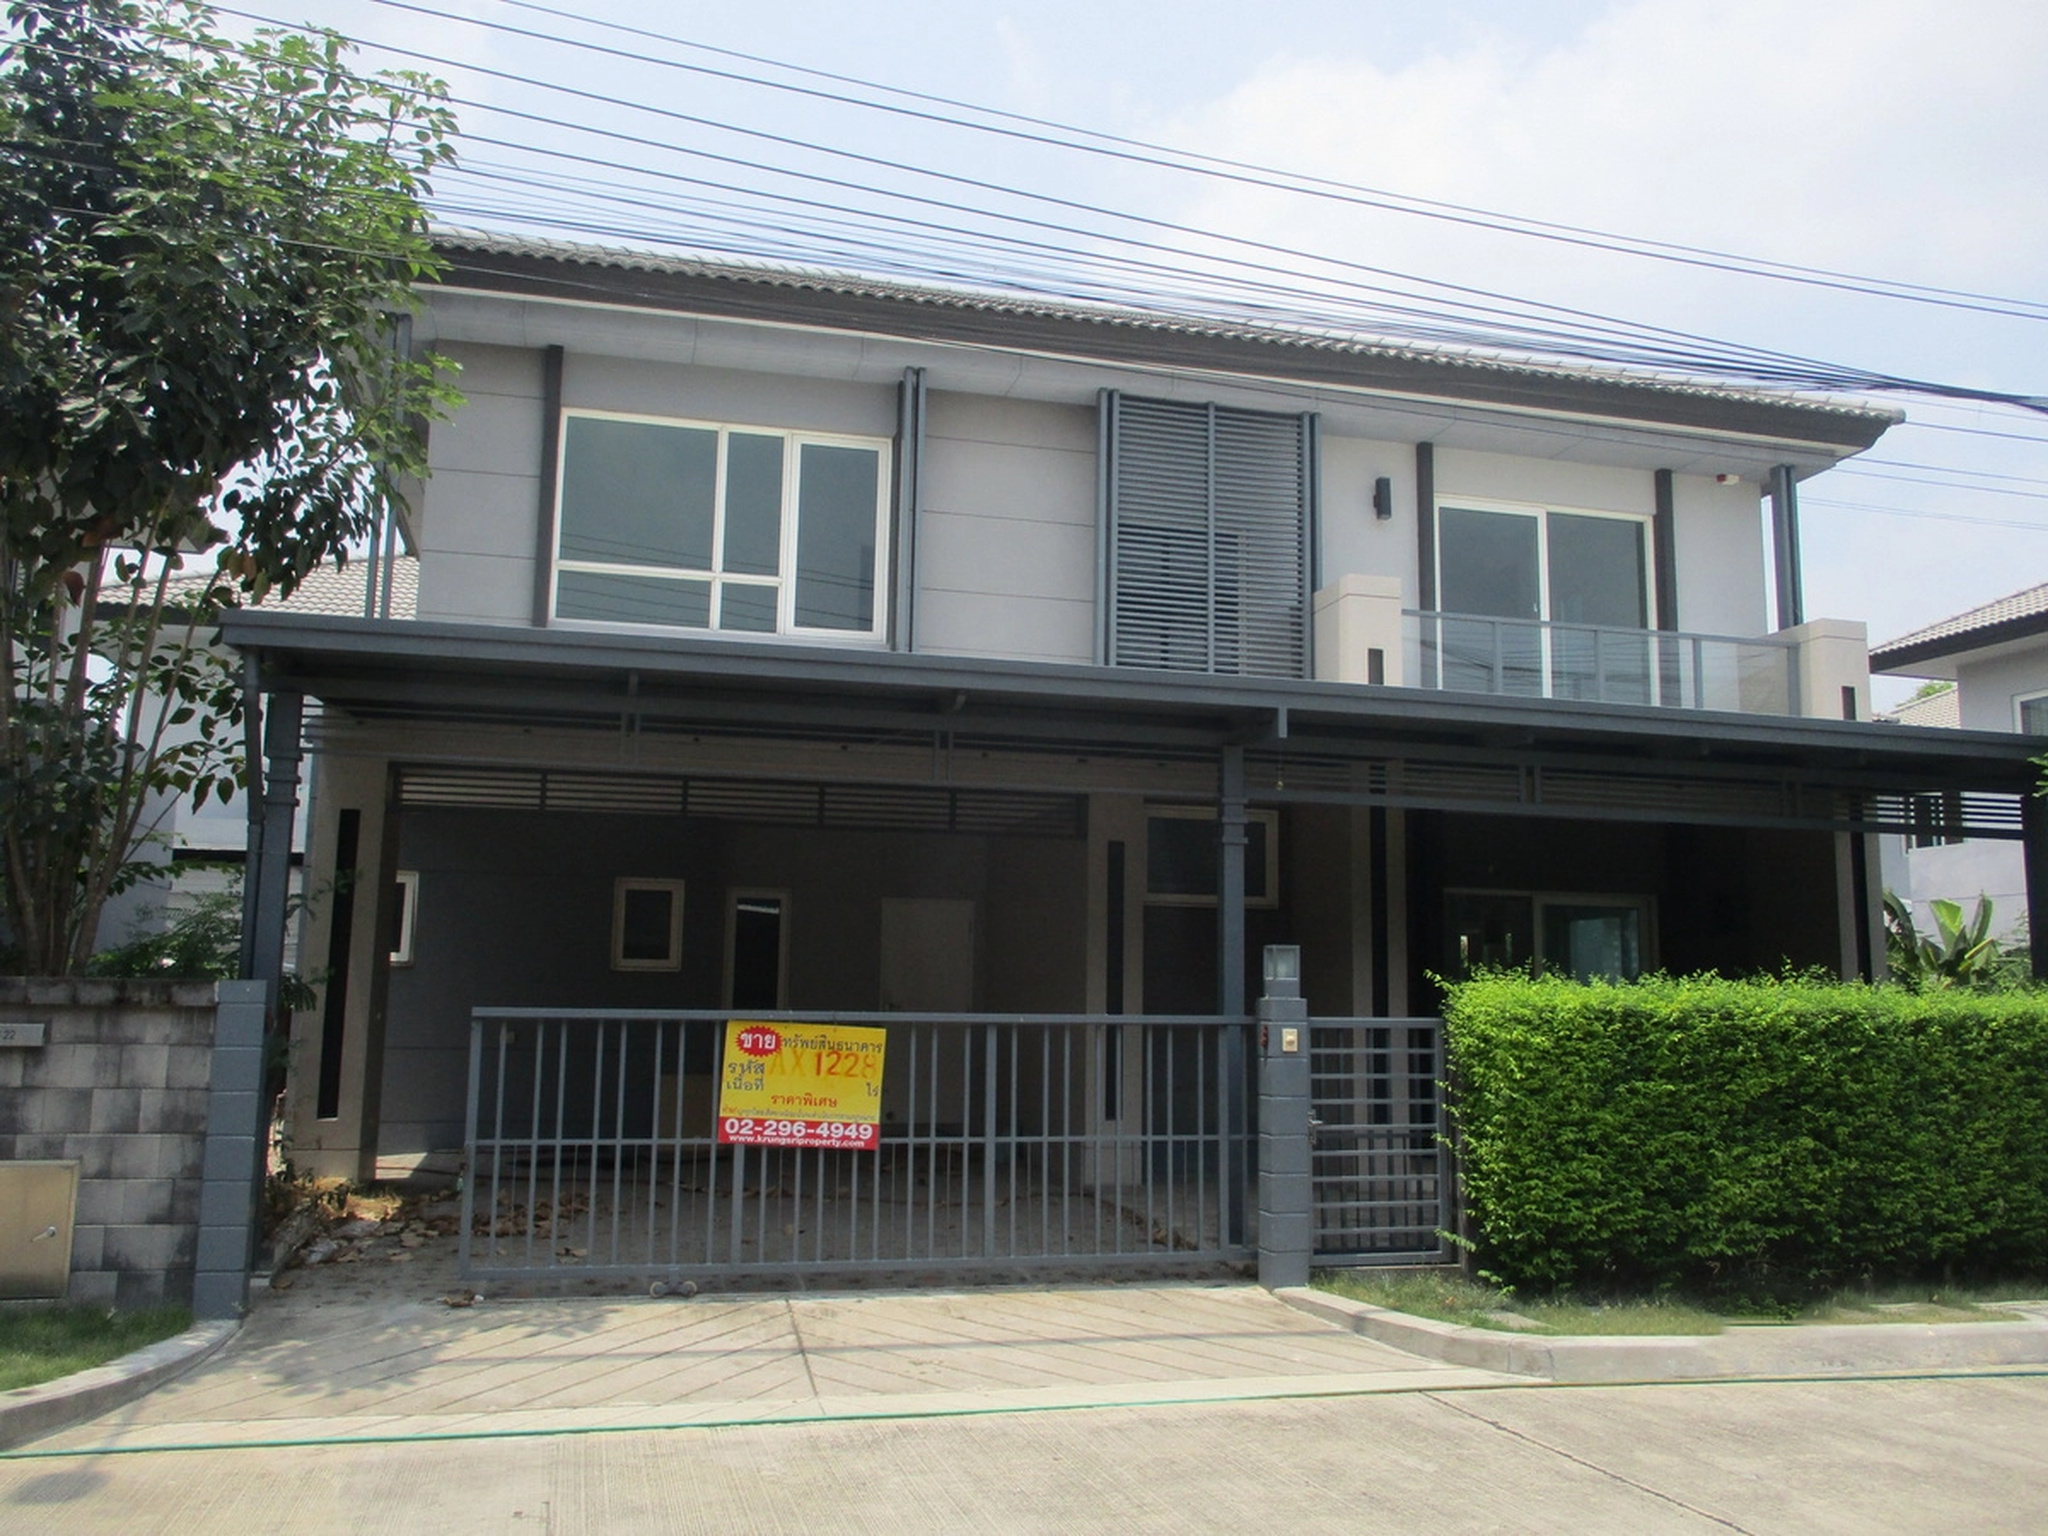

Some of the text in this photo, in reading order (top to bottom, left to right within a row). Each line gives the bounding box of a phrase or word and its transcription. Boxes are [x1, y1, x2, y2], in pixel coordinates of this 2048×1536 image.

[740, 1032, 883, 1053] ขาย ทรัพย์สินธนาคาร
[728, 1059, 765, 1074] รหัส
[726, 1073, 764, 1091] เนื้อที่
[770, 1092, 838, 1108] ราคาพิเศษ
[725, 1118, 873, 1140] 02-296-4949
[728, 1135, 865, 1148] www.krungsriproperty.com
